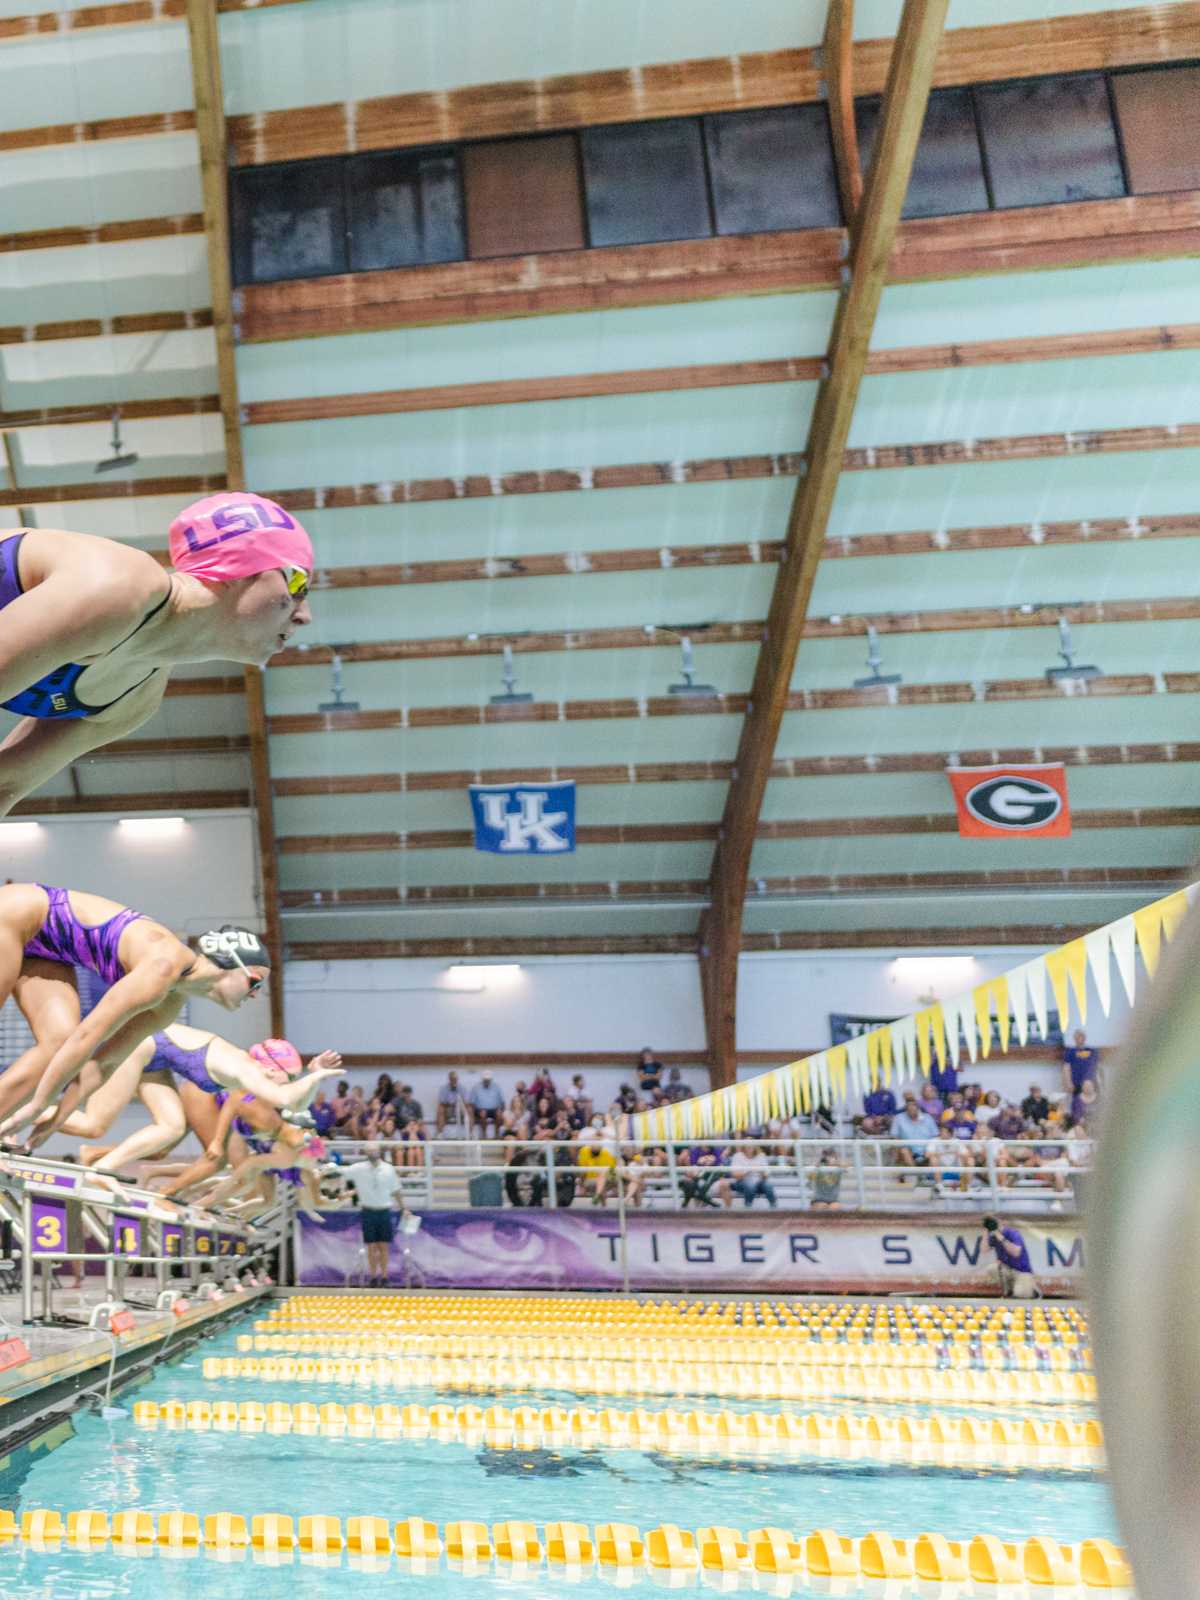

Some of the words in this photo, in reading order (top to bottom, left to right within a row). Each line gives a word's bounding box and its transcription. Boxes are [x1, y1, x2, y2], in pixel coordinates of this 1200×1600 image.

[184, 503, 295, 552] LSU
[50, 692, 68, 710] LSU
[989, 784, 1058, 820] G
[478, 792, 569, 852] UK
[199, 930, 260, 953] GCU
[36, 1215, 61, 1248] 3
[220, 1240, 230, 1254] 7
[597, 1232, 820, 1263] TIGER
[881, 1235, 1087, 1267] SWM
